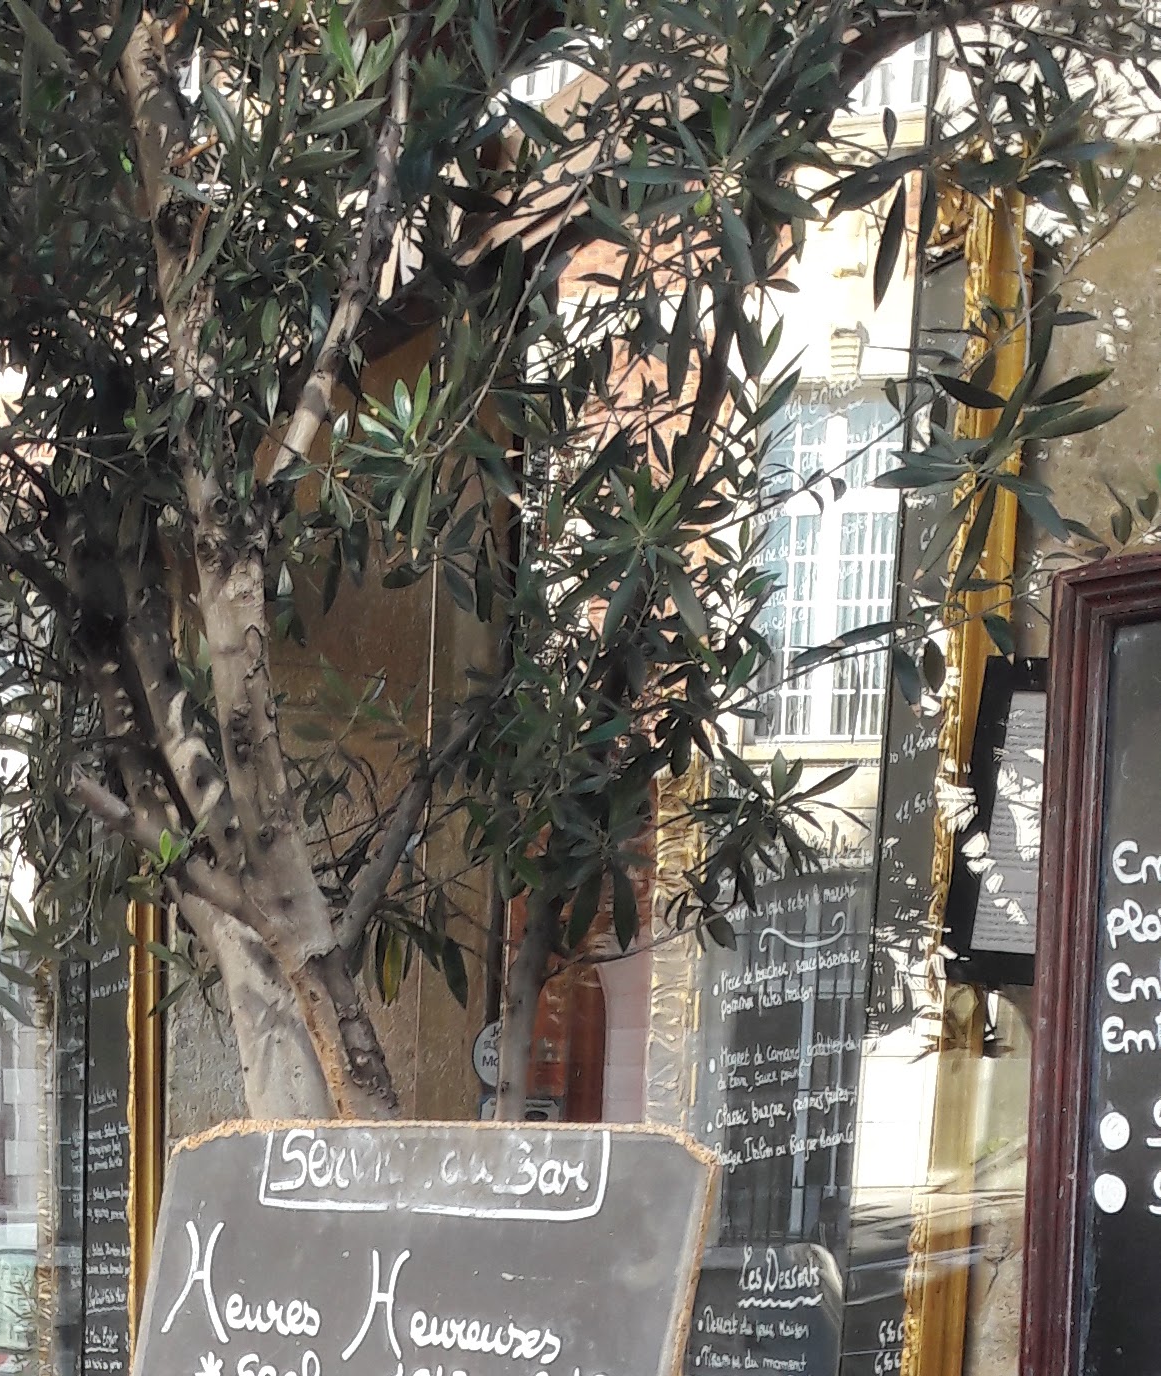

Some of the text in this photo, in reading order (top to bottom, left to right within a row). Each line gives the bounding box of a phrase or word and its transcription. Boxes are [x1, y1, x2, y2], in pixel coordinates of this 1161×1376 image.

[161, 1221, 320, 1343] Heures
[342, 1250, 560, 1363] Heureuses
[763, 1246, 821, 1295] Desserts
